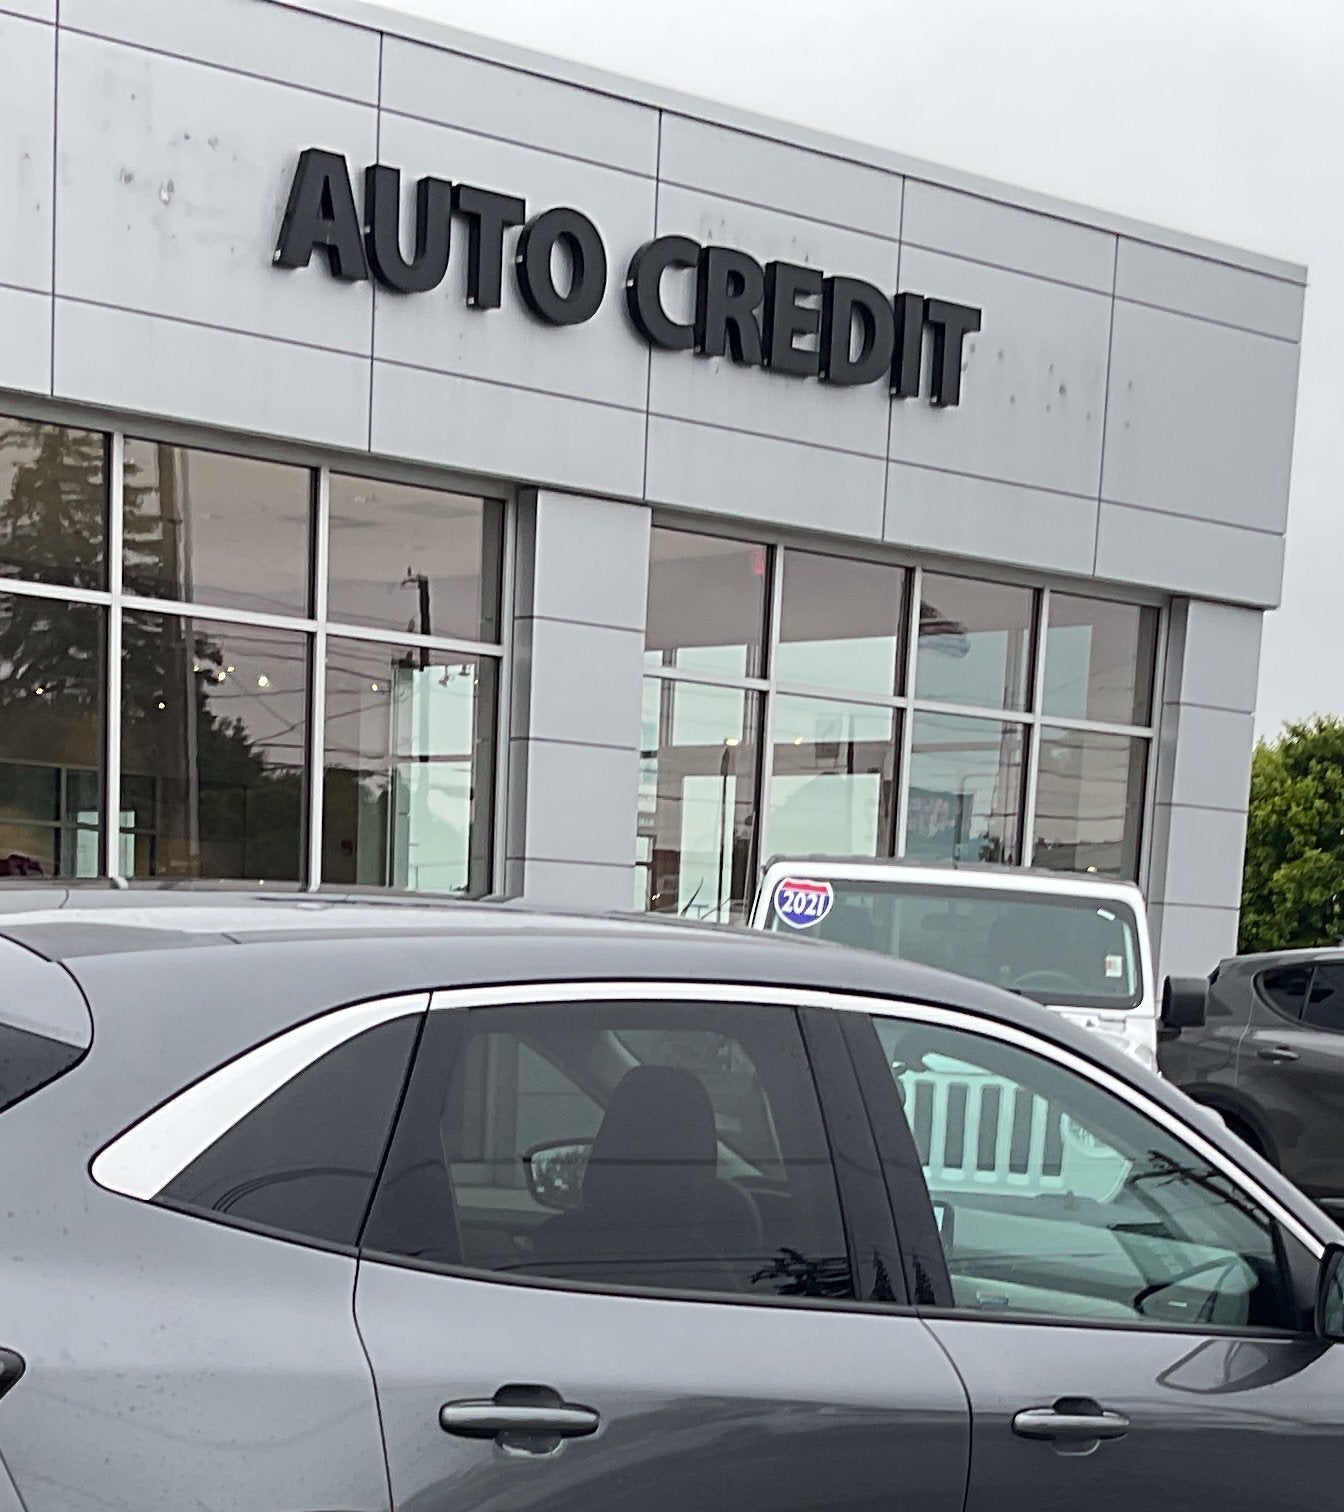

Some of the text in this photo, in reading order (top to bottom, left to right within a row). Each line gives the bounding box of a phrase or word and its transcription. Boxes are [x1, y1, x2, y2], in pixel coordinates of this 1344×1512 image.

[272, 147, 982, 408] AUTO CREDIT
[781, 890, 825, 917] 2021
